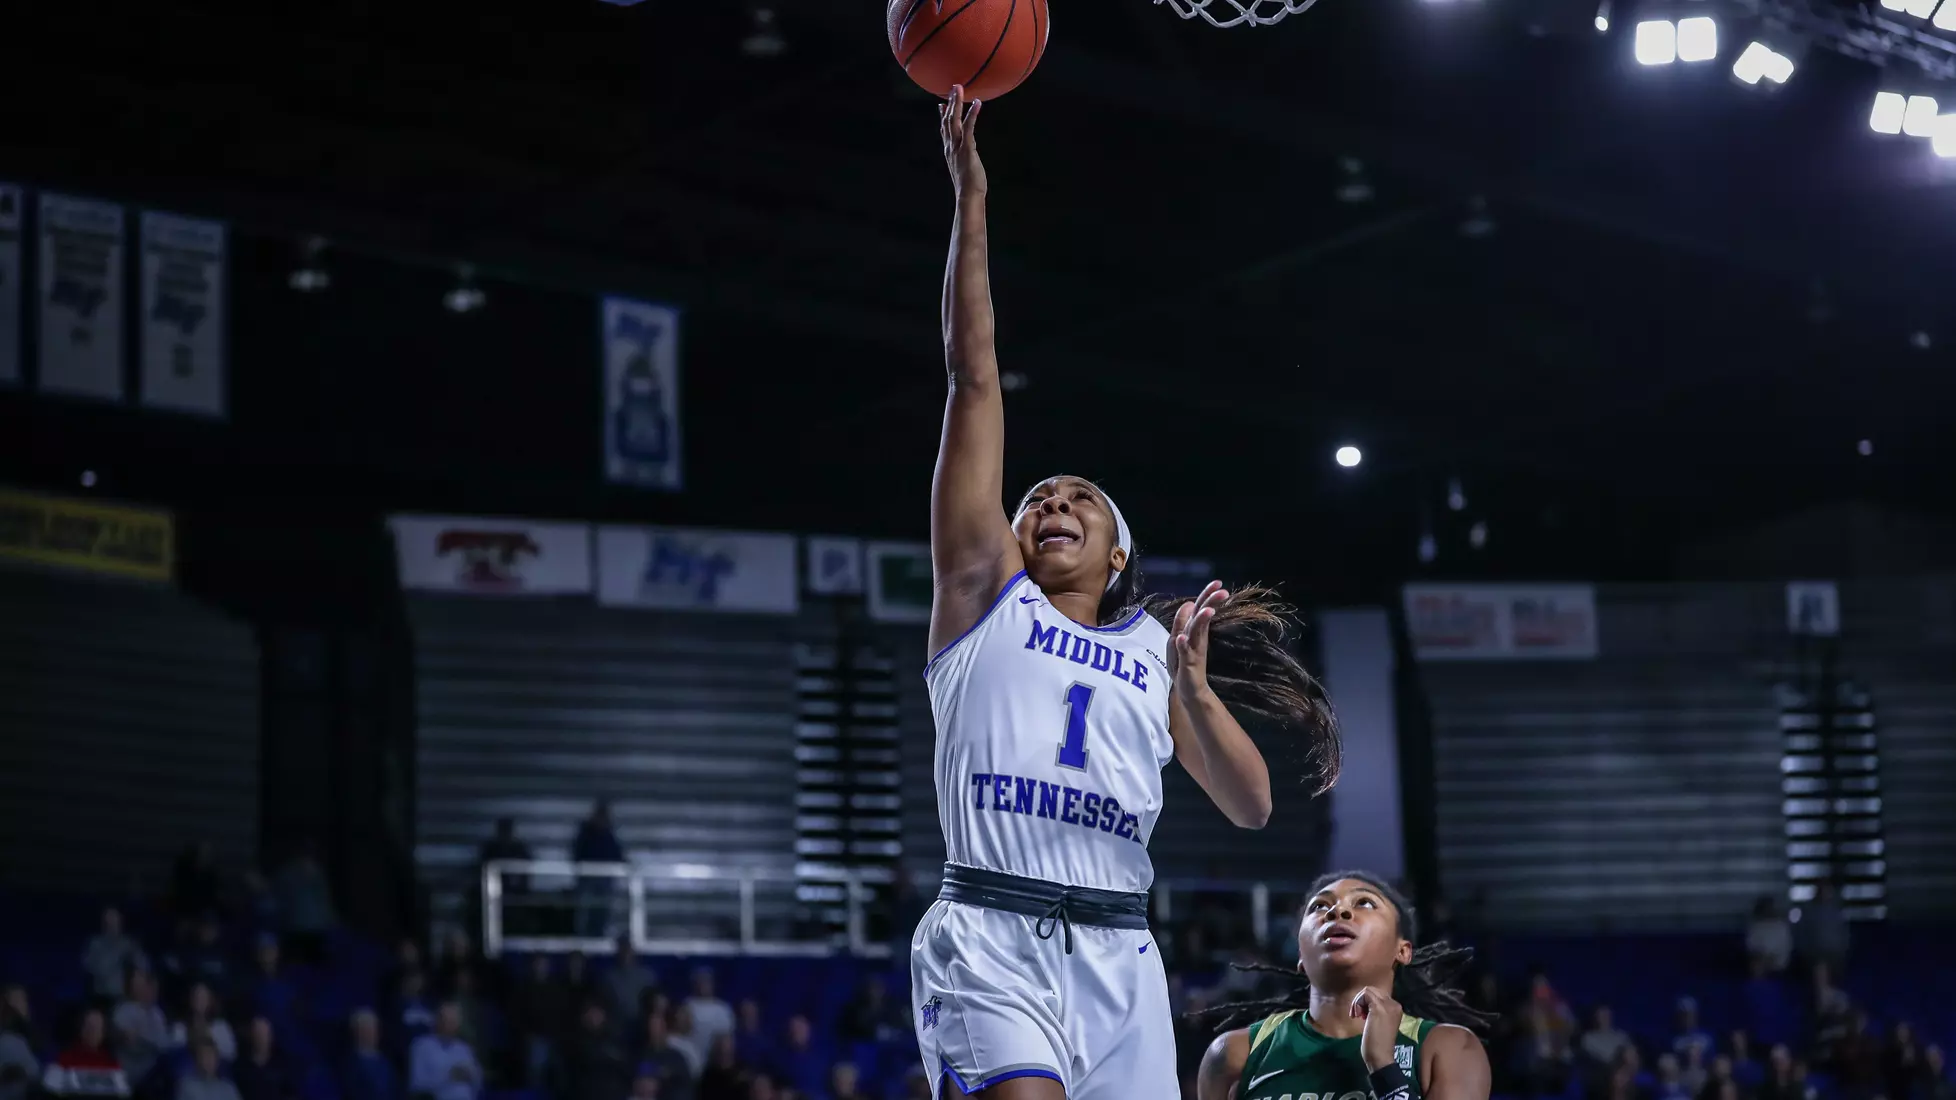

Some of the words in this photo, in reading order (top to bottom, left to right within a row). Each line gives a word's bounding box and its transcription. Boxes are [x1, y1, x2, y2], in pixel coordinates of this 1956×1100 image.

[1024, 619, 1149, 694] MIDDLE
[1055, 680, 1097, 774] 1
[971, 773, 1143, 845] TENNESSE
